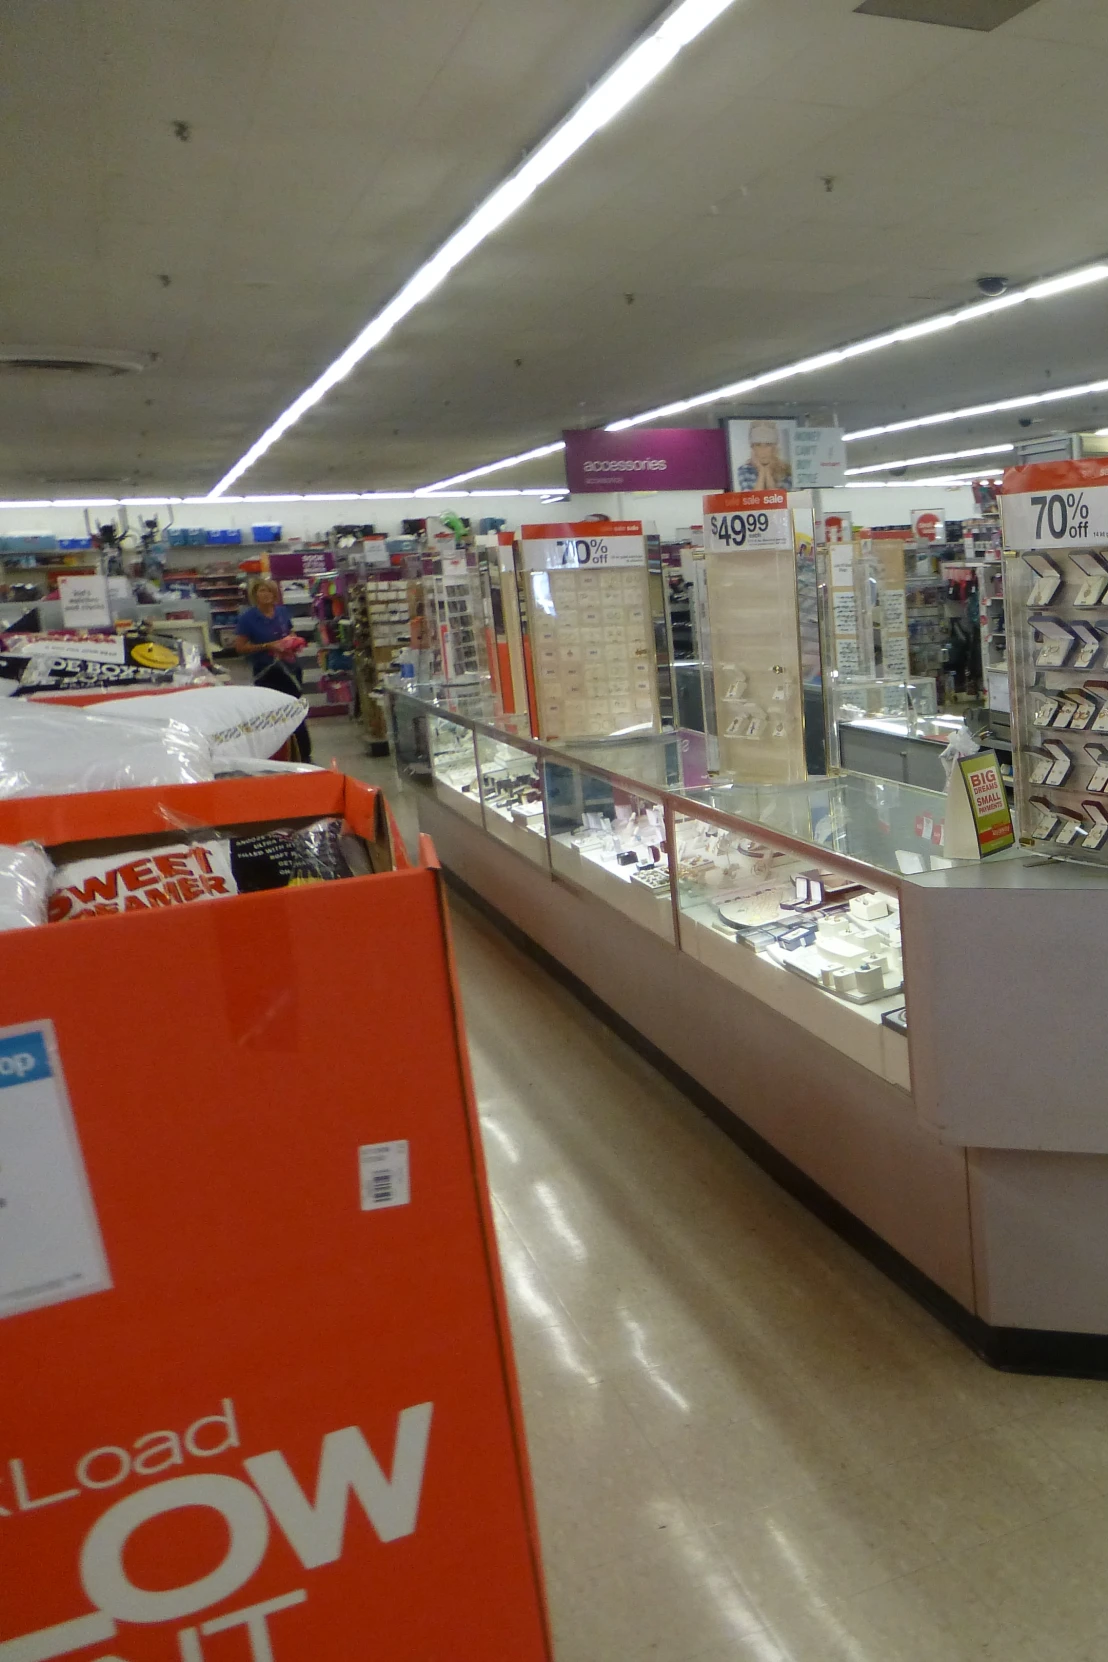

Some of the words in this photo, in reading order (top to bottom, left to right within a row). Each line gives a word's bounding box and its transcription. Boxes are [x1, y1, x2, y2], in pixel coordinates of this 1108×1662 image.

[583, 457, 667, 472] accessories
[742, 494, 761, 506] sale
[763, 494, 784, 505] sale
[1031, 492, 1089, 540] 70%
[1069, 521, 1089, 538] off
[556, 539, 608, 565] 70%
[592, 554, 608, 564] off
[970, 769, 996, 787] BIG
[973, 782, 998, 795] DREAMS
[976, 792, 1001, 807] SMALL
[978, 801, 1003, 814] PAYMENTS
[265, 844, 284, 853] WITH
[48, 846, 213, 922] SWEET
[0, 1398, 240, 1517] Load
[0, 1401, 434, 1662] OW
